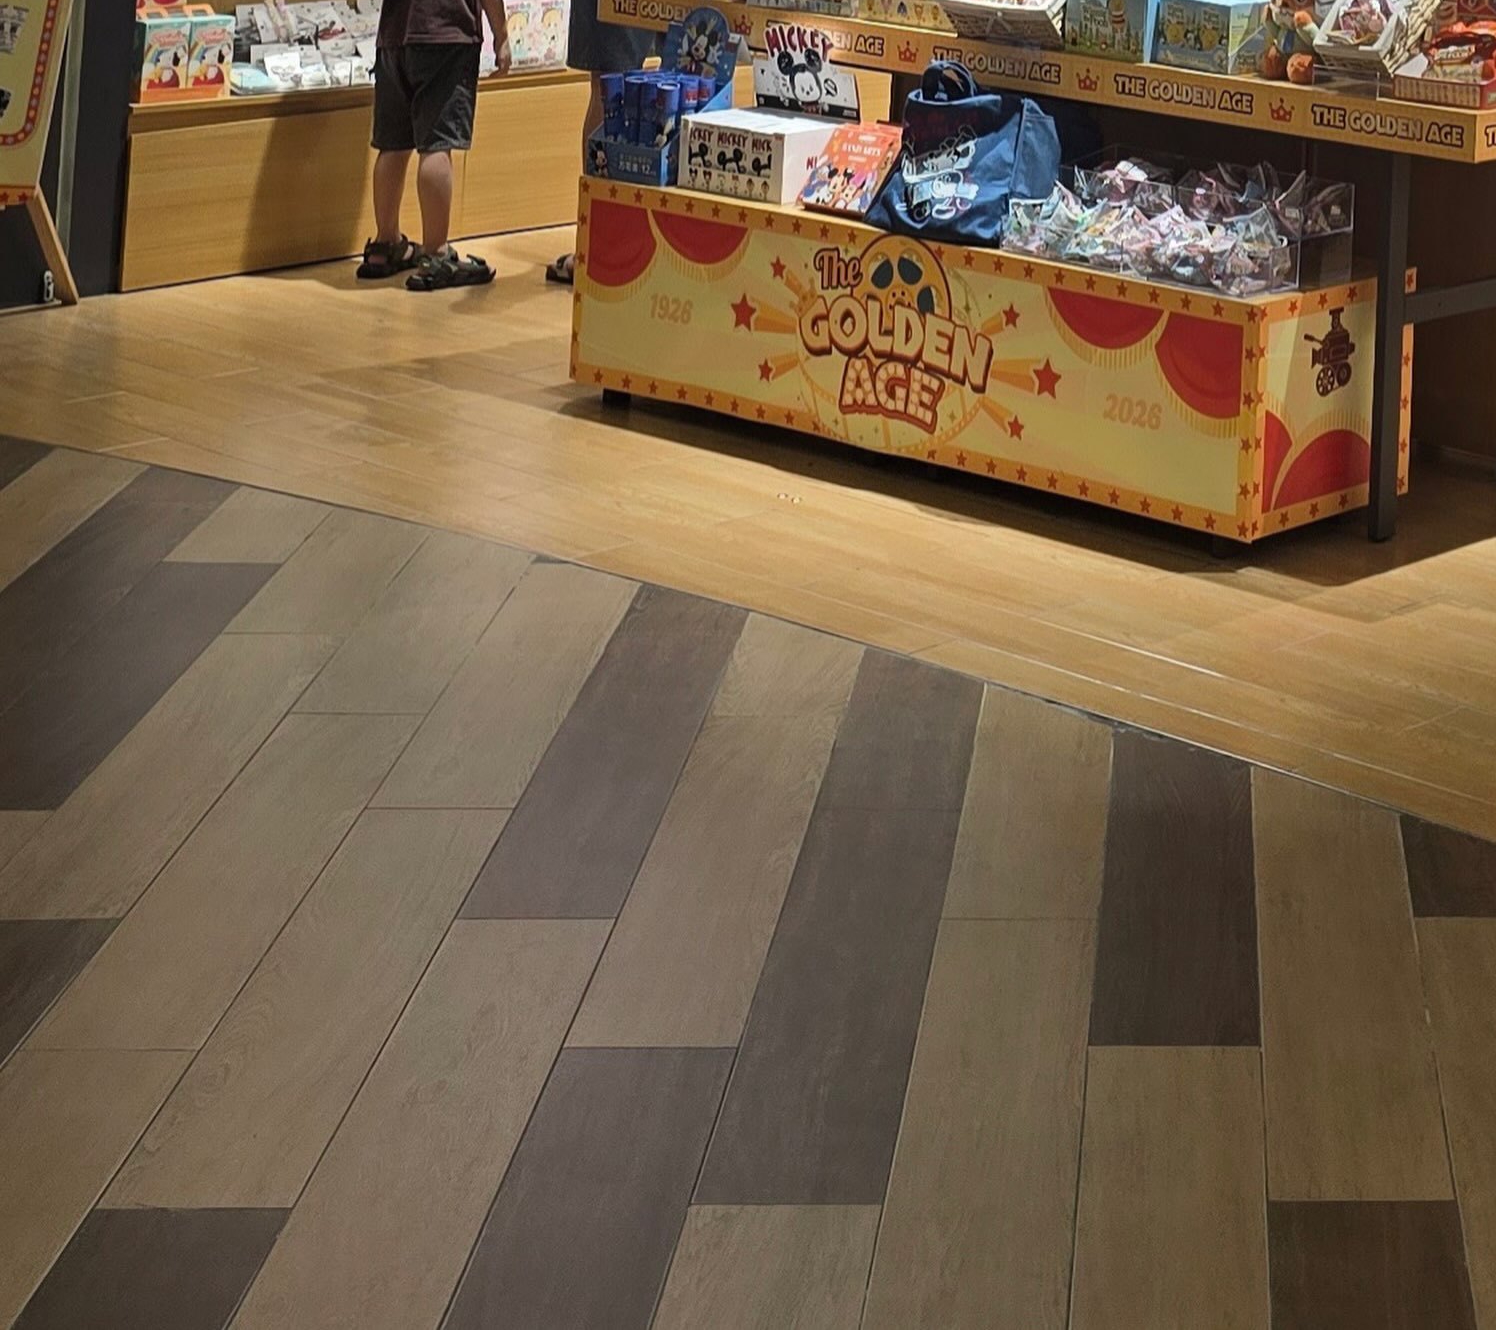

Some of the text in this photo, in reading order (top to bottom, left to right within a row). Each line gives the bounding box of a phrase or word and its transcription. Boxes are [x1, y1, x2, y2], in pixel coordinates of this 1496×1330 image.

[638, 0, 690, 22] GOLDE
[765, 24, 834, 62] MICKEY
[854, 34, 885, 56] AGE
[932, 46, 1060, 85] THE GOLDEN AGE
[1114, 74, 1253, 114] THE GOLDEN AGE
[717, 128, 748, 149] MICKEY
[1311, 104, 1464, 147] THE GOLDEN AGE
[814, 246, 863, 291] The
[649, 293, 693, 325] 1926
[800, 294, 994, 394] GOLDEN
[838, 356, 946, 435] AGE
[1103, 392, 1163, 431] 2026
